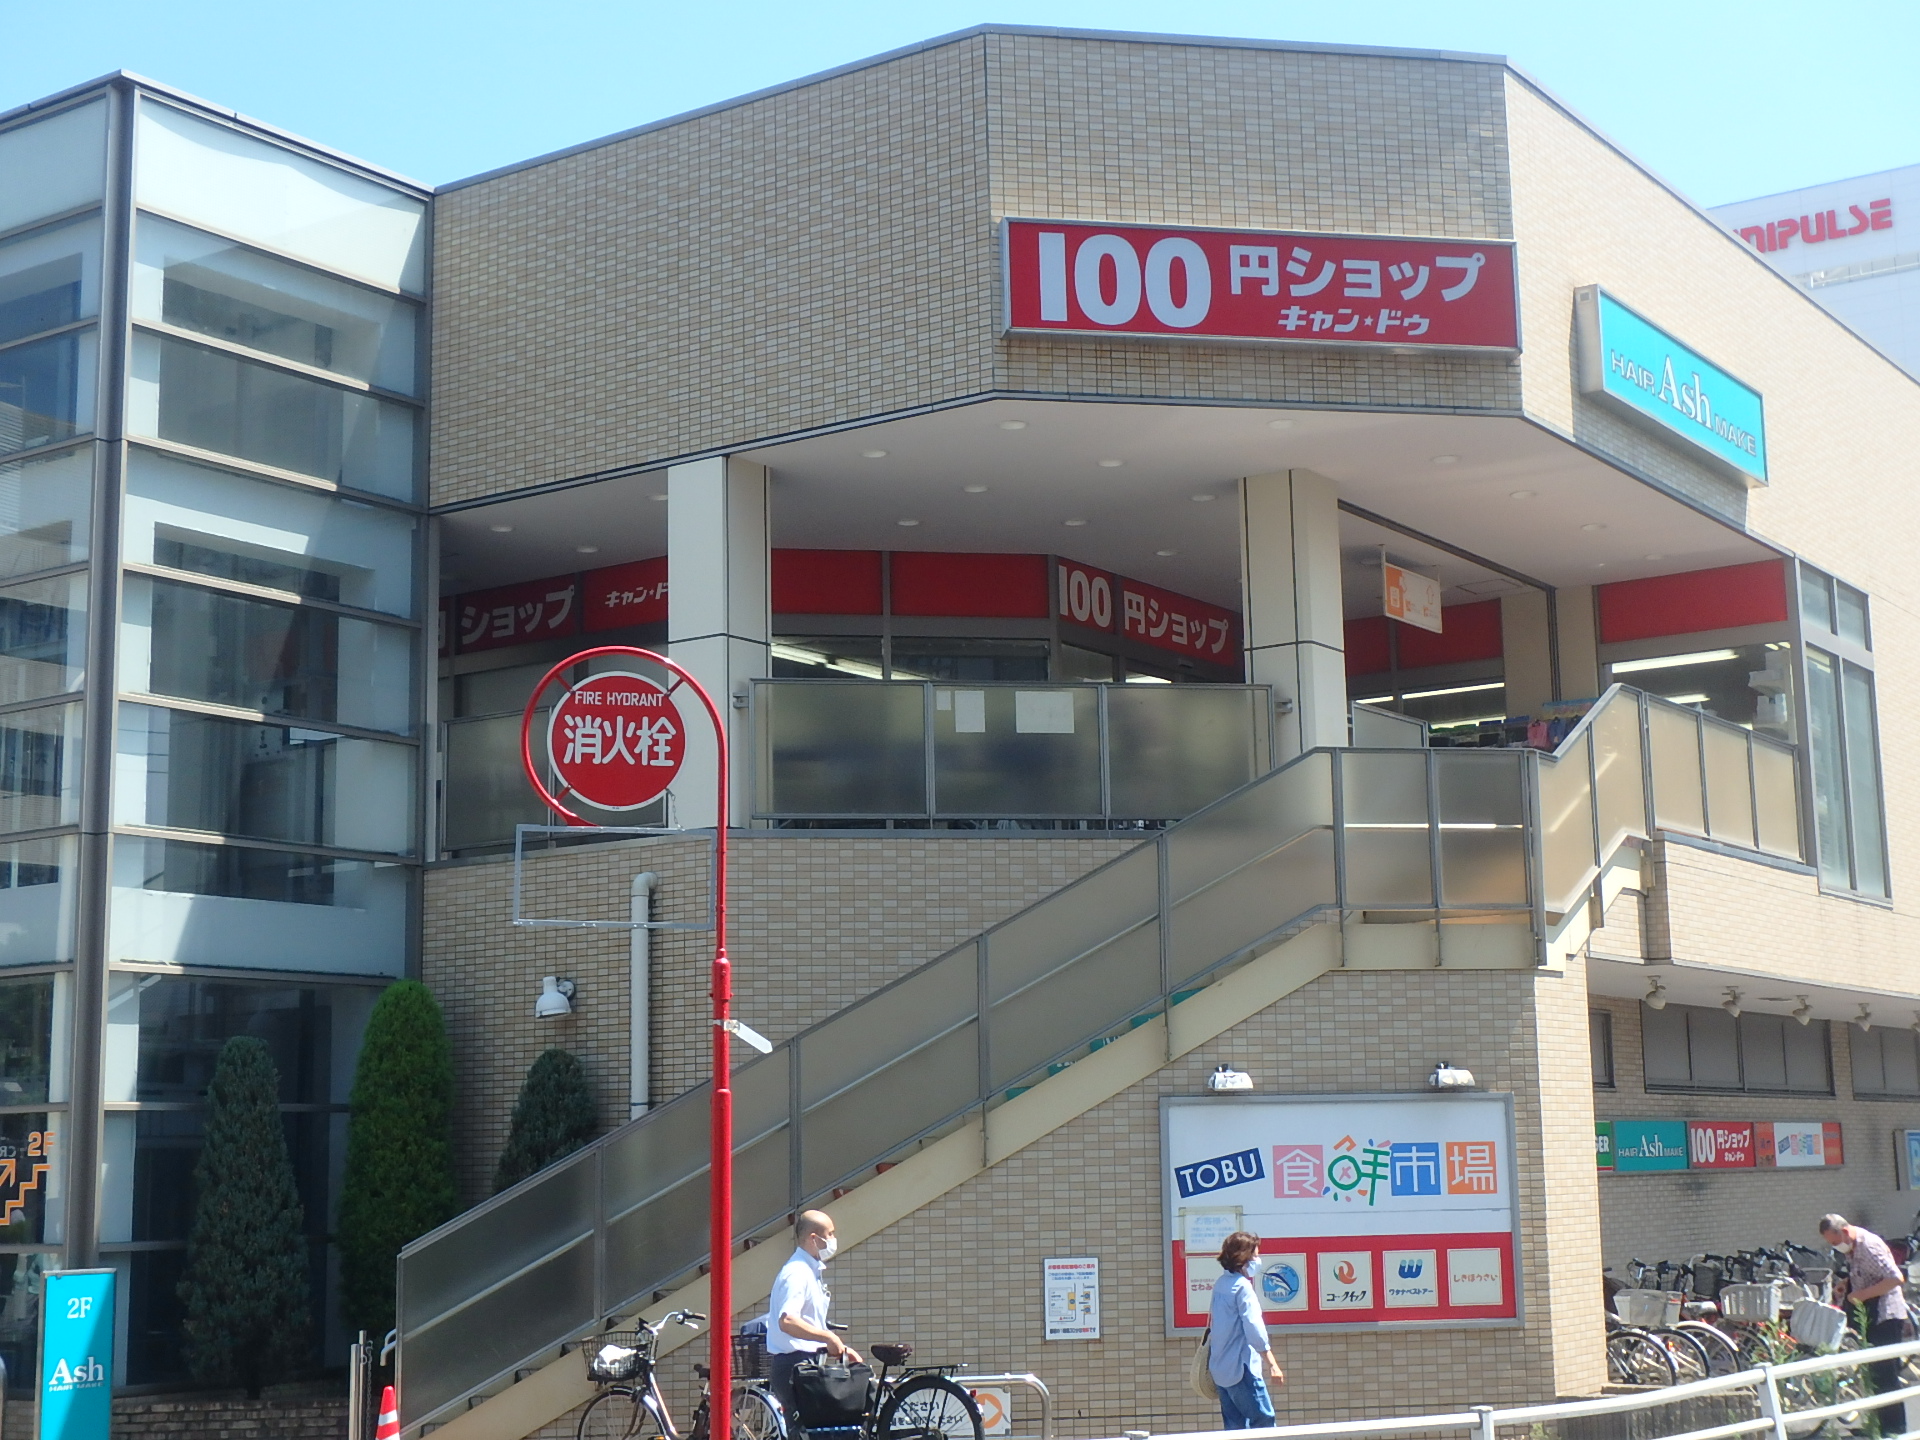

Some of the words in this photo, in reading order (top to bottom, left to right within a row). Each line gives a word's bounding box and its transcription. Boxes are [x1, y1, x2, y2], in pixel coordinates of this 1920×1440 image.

[1733, 198, 1893, 254] NIPULSE
[1038, 231, 1486, 329] 100円ショップ
[1611, 348, 1656, 396] HAIR
[1658, 354, 1713, 432] Ash
[1714, 413, 1757, 458] MAKE
[1058, 564, 1229, 654] 100円ショップ
[574, 691, 602, 706] FIRE
[606, 691, 665, 707] HYDRANT
[563, 714, 677, 767] 消火栓
[27, 1131, 57, 1157] 2F
[1618, 1147, 1638, 1157] HAIR
[1639, 1134, 1664, 1157] Ash
[1664, 1146, 1684, 1157] MAKE
[1178, 1152, 1259, 1193] TOBU
[1275, 1135, 1495, 1206] 食鮮市場
[1388, 1288, 1434, 1296] ワタナベストアー
[1453, 1273, 1499, 1283] しきほうさい
[67, 1296, 93, 1319] 2F
[48, 1356, 104, 1385] Ash
